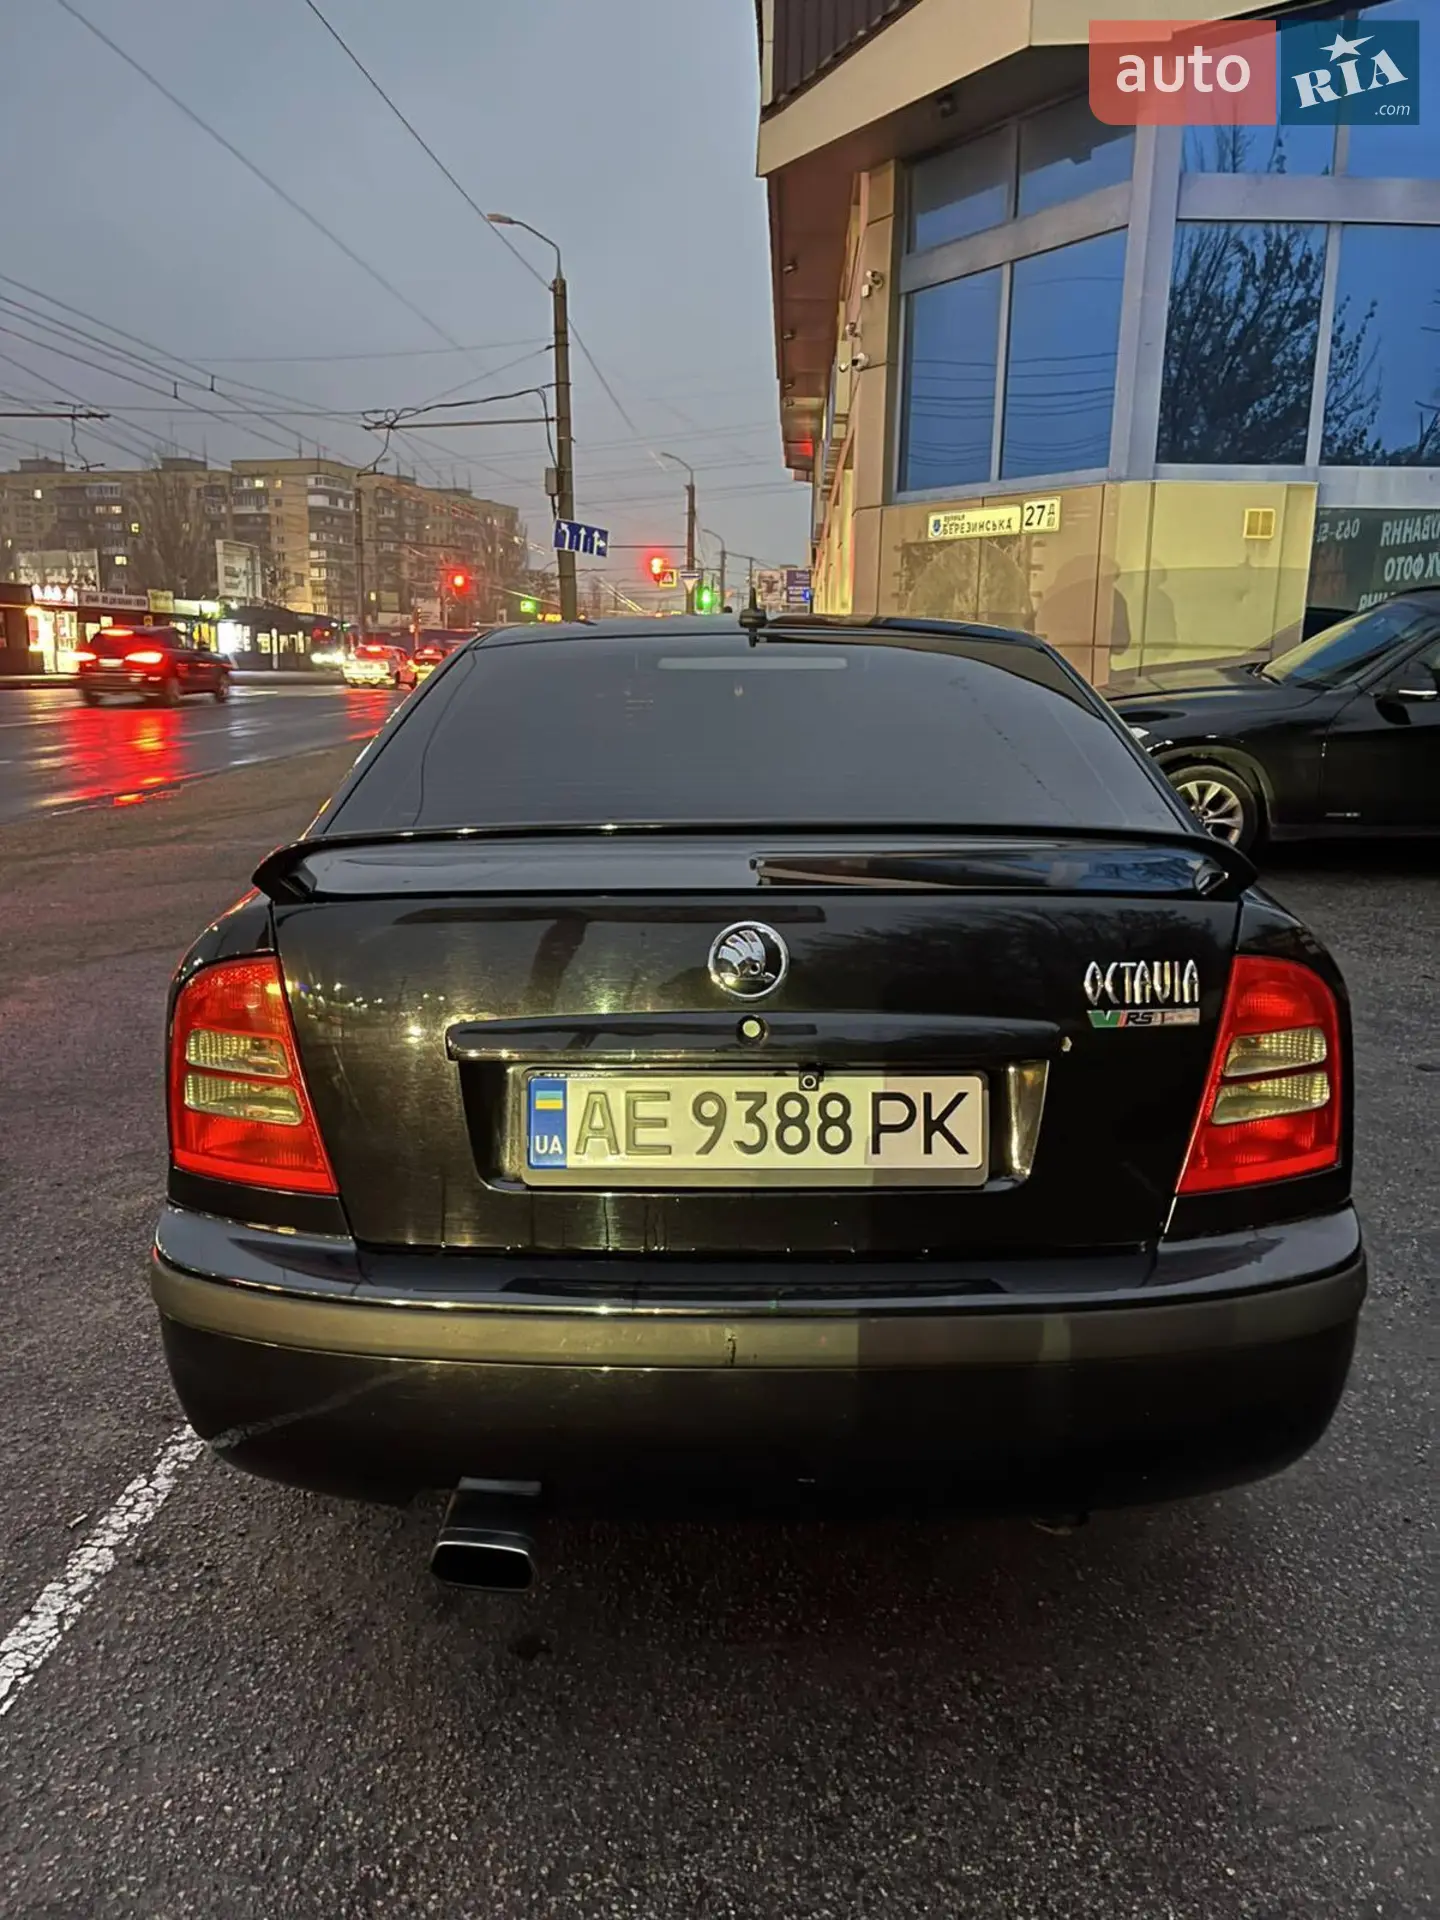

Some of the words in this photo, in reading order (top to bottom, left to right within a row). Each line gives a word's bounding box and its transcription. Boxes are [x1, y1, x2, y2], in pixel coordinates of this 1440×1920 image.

[943, 517, 1013, 535] БЕРЕЗИНСЬКА
[1025, 505, 1046, 526] 27
[1083, 959, 1200, 1006] OCTAVIA
[574, 1090, 673, 1156] AE
[691, 1090, 853, 1156] 9388
[871, 1091, 969, 1155] PK
[535, 1135, 564, 1155] UA
